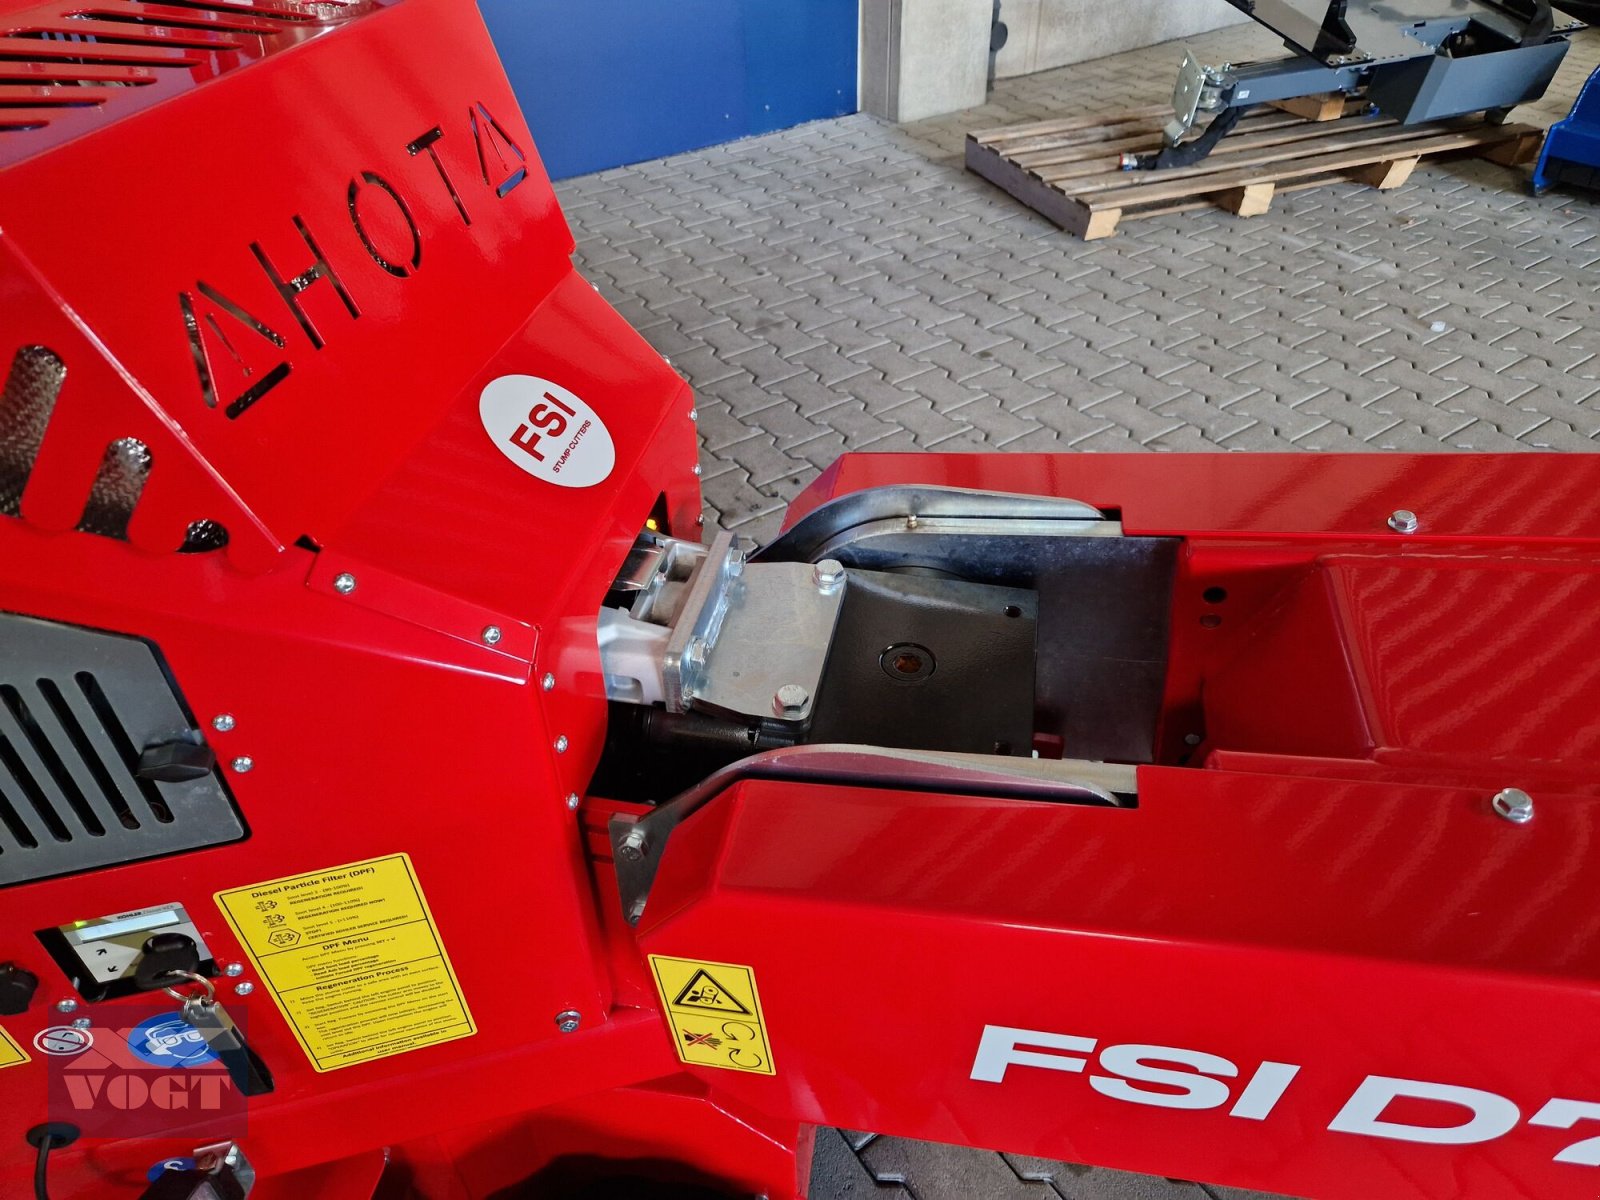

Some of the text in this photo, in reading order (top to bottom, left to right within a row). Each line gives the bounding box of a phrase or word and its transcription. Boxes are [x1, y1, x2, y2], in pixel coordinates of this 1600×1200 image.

[249, 125, 470, 350] HOT
[509, 391, 577, 462] FSI
[553, 420, 592, 473] STUMP CUTTERS
[252, 867, 374, 898] Diesel Particle Filter (DPF)
[322, 937, 369, 950] DPF Menu
[316, 967, 408, 990] Regeneration Process
[343, 1048, 374, 1058] Additional
[376, 1039, 412, 1049] information
[413, 1032, 439, 1040] available
[392, 1042, 416, 1050] manual.
[970, 1024, 1302, 1121] FSI
